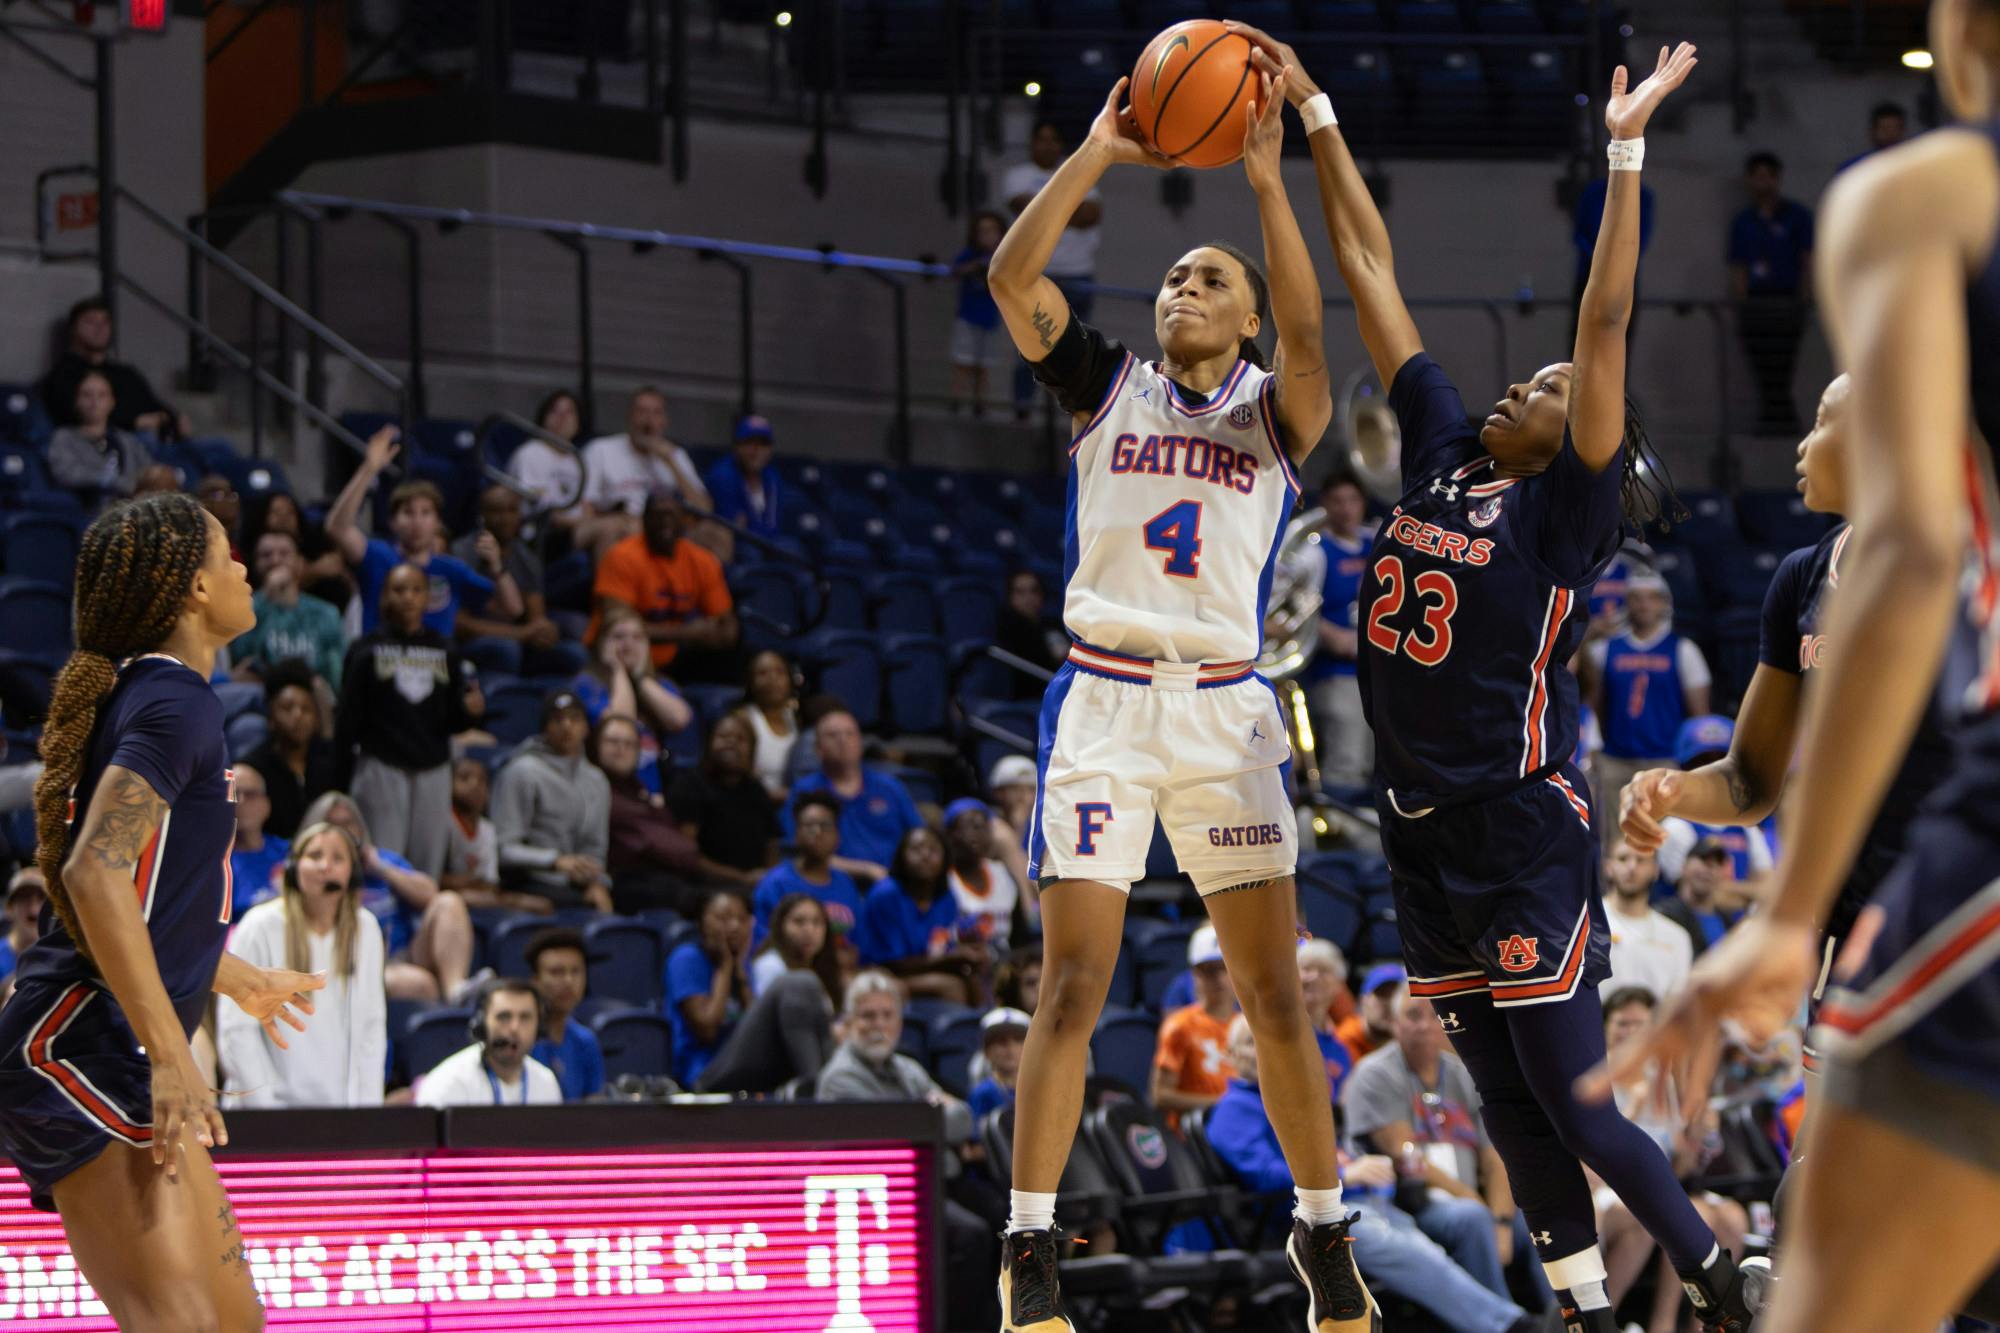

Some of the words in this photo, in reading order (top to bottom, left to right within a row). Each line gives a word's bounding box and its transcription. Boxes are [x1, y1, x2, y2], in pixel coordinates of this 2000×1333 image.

[1231, 405, 1252, 425] SEC
[1110, 432, 1259, 496] GATORS
[1142, 498, 1203, 579] 4
[1367, 554, 1459, 667] 23
[1074, 802, 1115, 857] F
[1208, 822, 1283, 847] GATORS
[338, 1228, 557, 1306] ACROSS
[564, 1227, 664, 1296] THE
[673, 1222, 768, 1292] SEC
